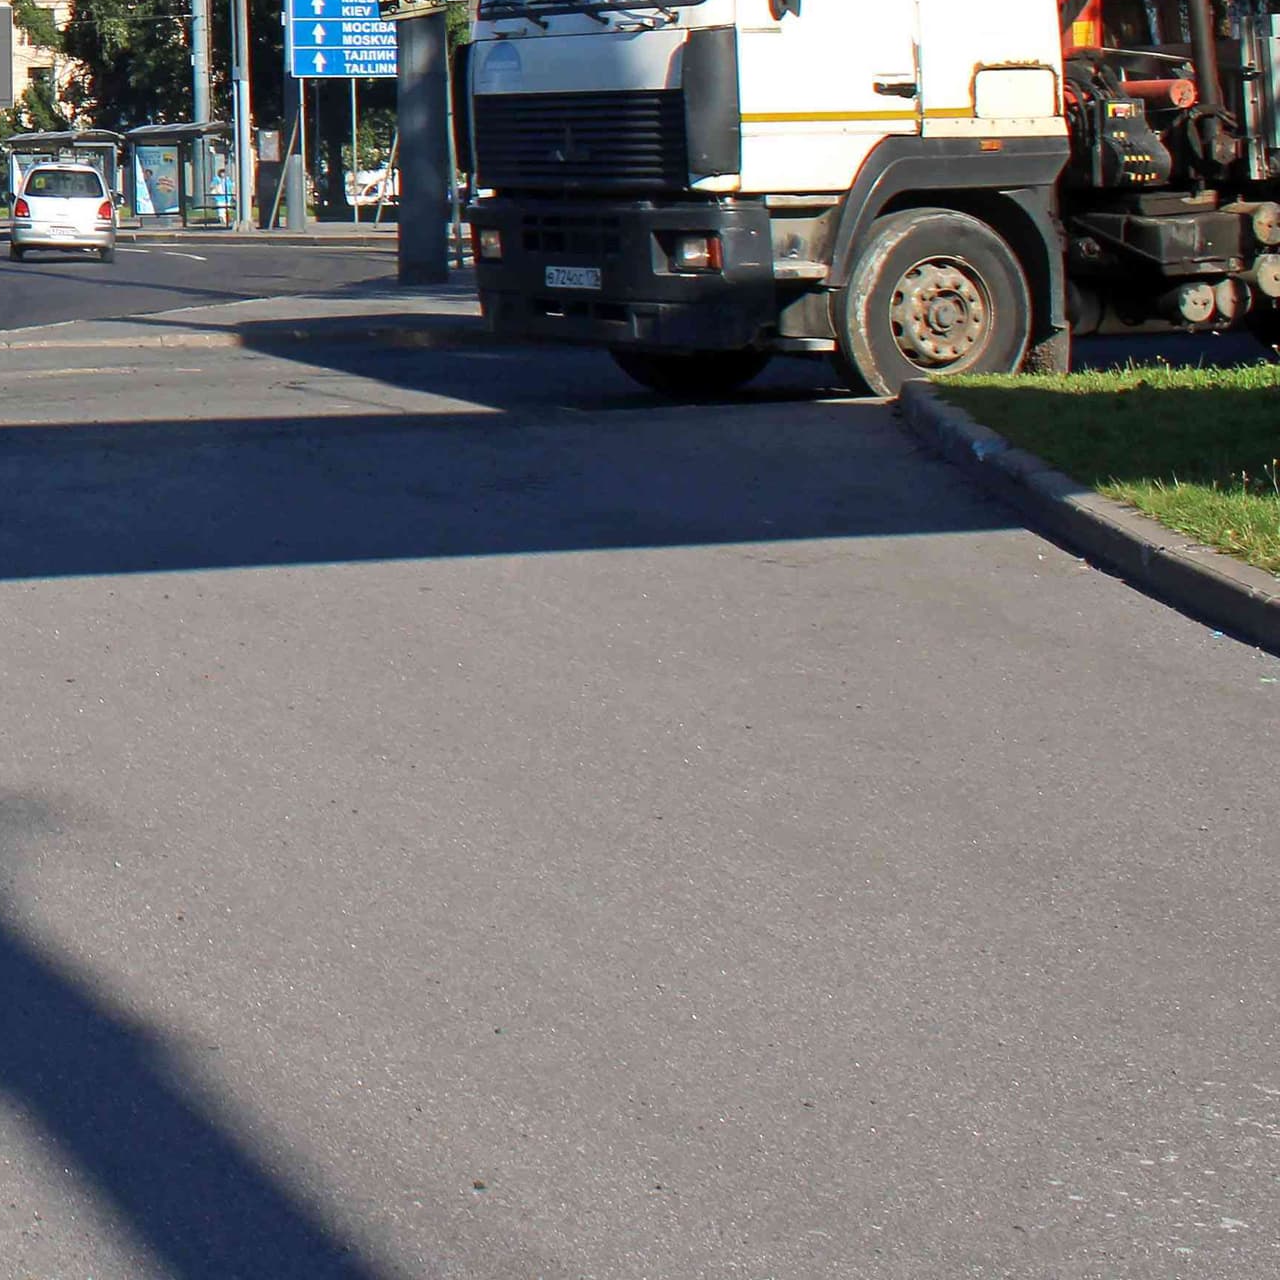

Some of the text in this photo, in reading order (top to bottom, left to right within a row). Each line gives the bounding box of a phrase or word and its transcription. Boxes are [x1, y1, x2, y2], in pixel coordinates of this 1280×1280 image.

[341, 6, 372, 17] KIEV
[342, 21, 397, 33] МОСКВА
[342, 34, 397, 45] MOSKVA
[343, 50, 396, 61] ТАЛЛИН
[344, 62, 397, 74] TALLINN
